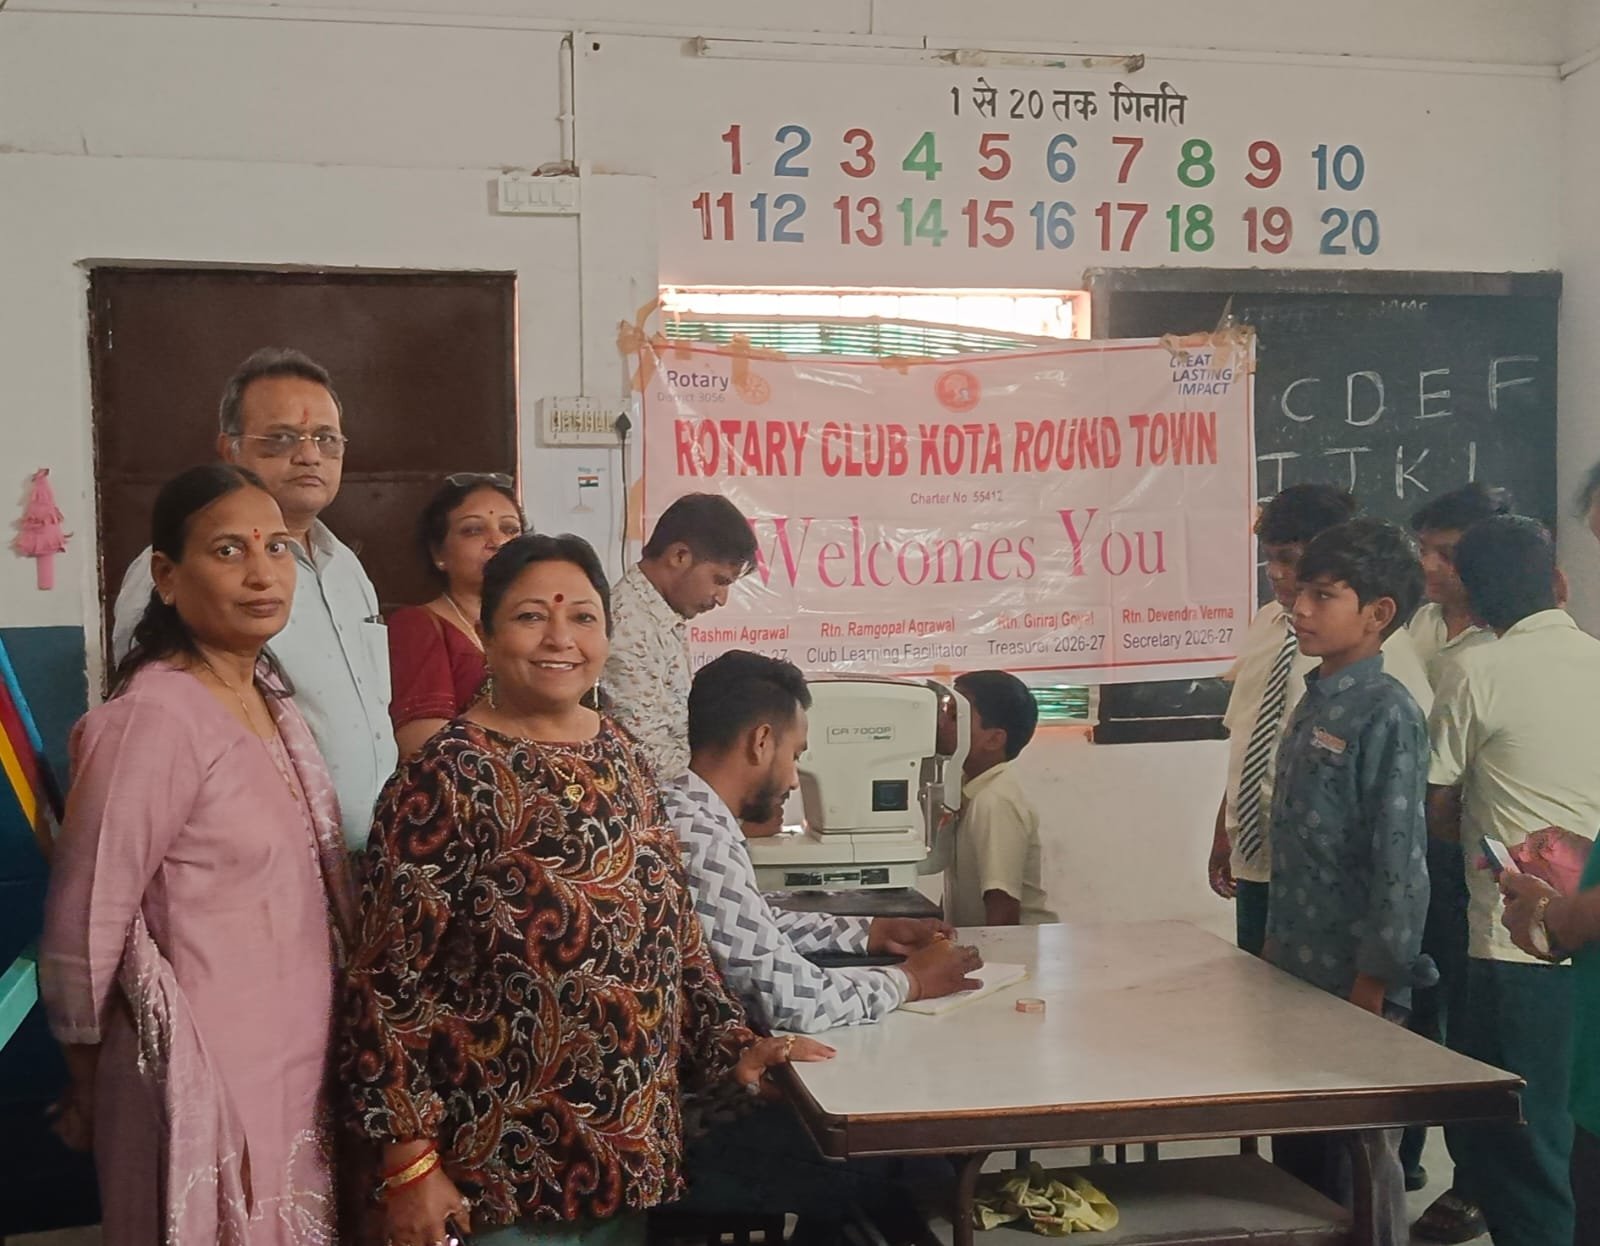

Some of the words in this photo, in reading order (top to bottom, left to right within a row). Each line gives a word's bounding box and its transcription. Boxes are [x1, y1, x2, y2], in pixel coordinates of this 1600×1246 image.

[950, 86, 960, 117] 1
[972, 77, 999, 118] से
[1009, 88, 1044, 120] 20
[1052, 89, 1098, 122] तक
[721, 124, 742, 175] 1
[774, 124, 812, 178] 2
[839, 127, 876, 179] 3
[902, 131, 943, 181] 4
[977, 132, 1012, 181] 5
[1046, 133, 1078, 183] 6
[1111, 136, 1144, 184] 7
[1176, 138, 1216, 187] 8
[1244, 140, 1282, 189] 9
[1311, 143, 1365, 192] 10
[691, 191, 735, 241] 11
[749, 192, 806, 243] 12
[833, 195, 884, 247] 13
[897, 197, 948, 247] 14
[961, 198, 1015, 249] 15
[1029, 200, 1076, 251] 16
[1094, 201, 1149, 252] 17
[1165, 203, 1215, 253] 18
[1242, 206, 1293, 255] 19
[1319, 207, 1380, 256] 20
[1169, 353, 1213, 368] CEAT
[666, 369, 729, 391] Rotary
[1172, 368, 1232, 383] LASTING
[657, 391, 694, 402] Disrict
[1178, 382, 1231, 395] IMPACT
[1281, 377, 1321, 422] C
[1344, 370, 1386, 426] D
[1414, 368, 1452, 420] E
[1487, 354, 1539, 411] F
[673, 418, 810, 478] ROTARY
[820, 421, 909, 478] CLUB
[918, 422, 1003, 476] KOTA
[1012, 416, 1122, 474] ROUND
[1128, 411, 1218, 468] TOWN
[1395, 445, 1430, 500] K
[910, 492, 951, 505] Charter
[746, 515, 1036, 589] Welcomes
[1056, 508, 1167, 577] You
[1147, 605, 1198, 622] Devendra
[1200, 604, 1234, 620] Verma
[690, 626, 737, 643] Rashmi
[740, 624, 790, 645] Agrawal
[849, 620, 905, 641] Ramgopal
[908, 617, 956, 636] Agrawal
[1123, 632, 1182, 650] Secretary
[1185, 627, 1234, 646] 2026-27
[806, 646, 839, 665] Club
[841, 644, 900, 665] Learning
[904, 641, 968, 662] Facilitator
[987, 639, 1049, 655] Treasurer
[1054, 634, 1106, 652] 2026-27
